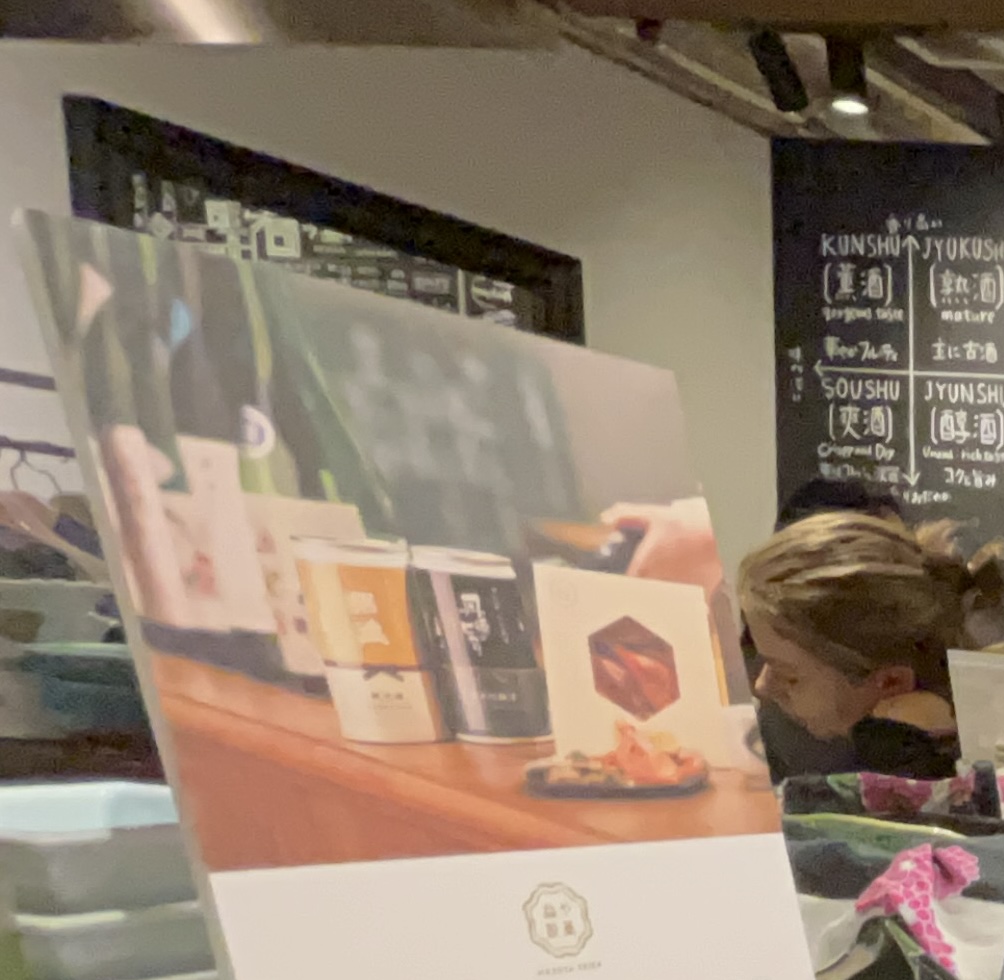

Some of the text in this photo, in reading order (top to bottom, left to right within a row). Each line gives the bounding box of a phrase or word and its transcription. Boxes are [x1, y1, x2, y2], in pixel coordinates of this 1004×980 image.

[821, 232, 901, 258] KUNSHU
[940, 309, 996, 324] mature
[821, 377, 901, 402] SOUSHU
